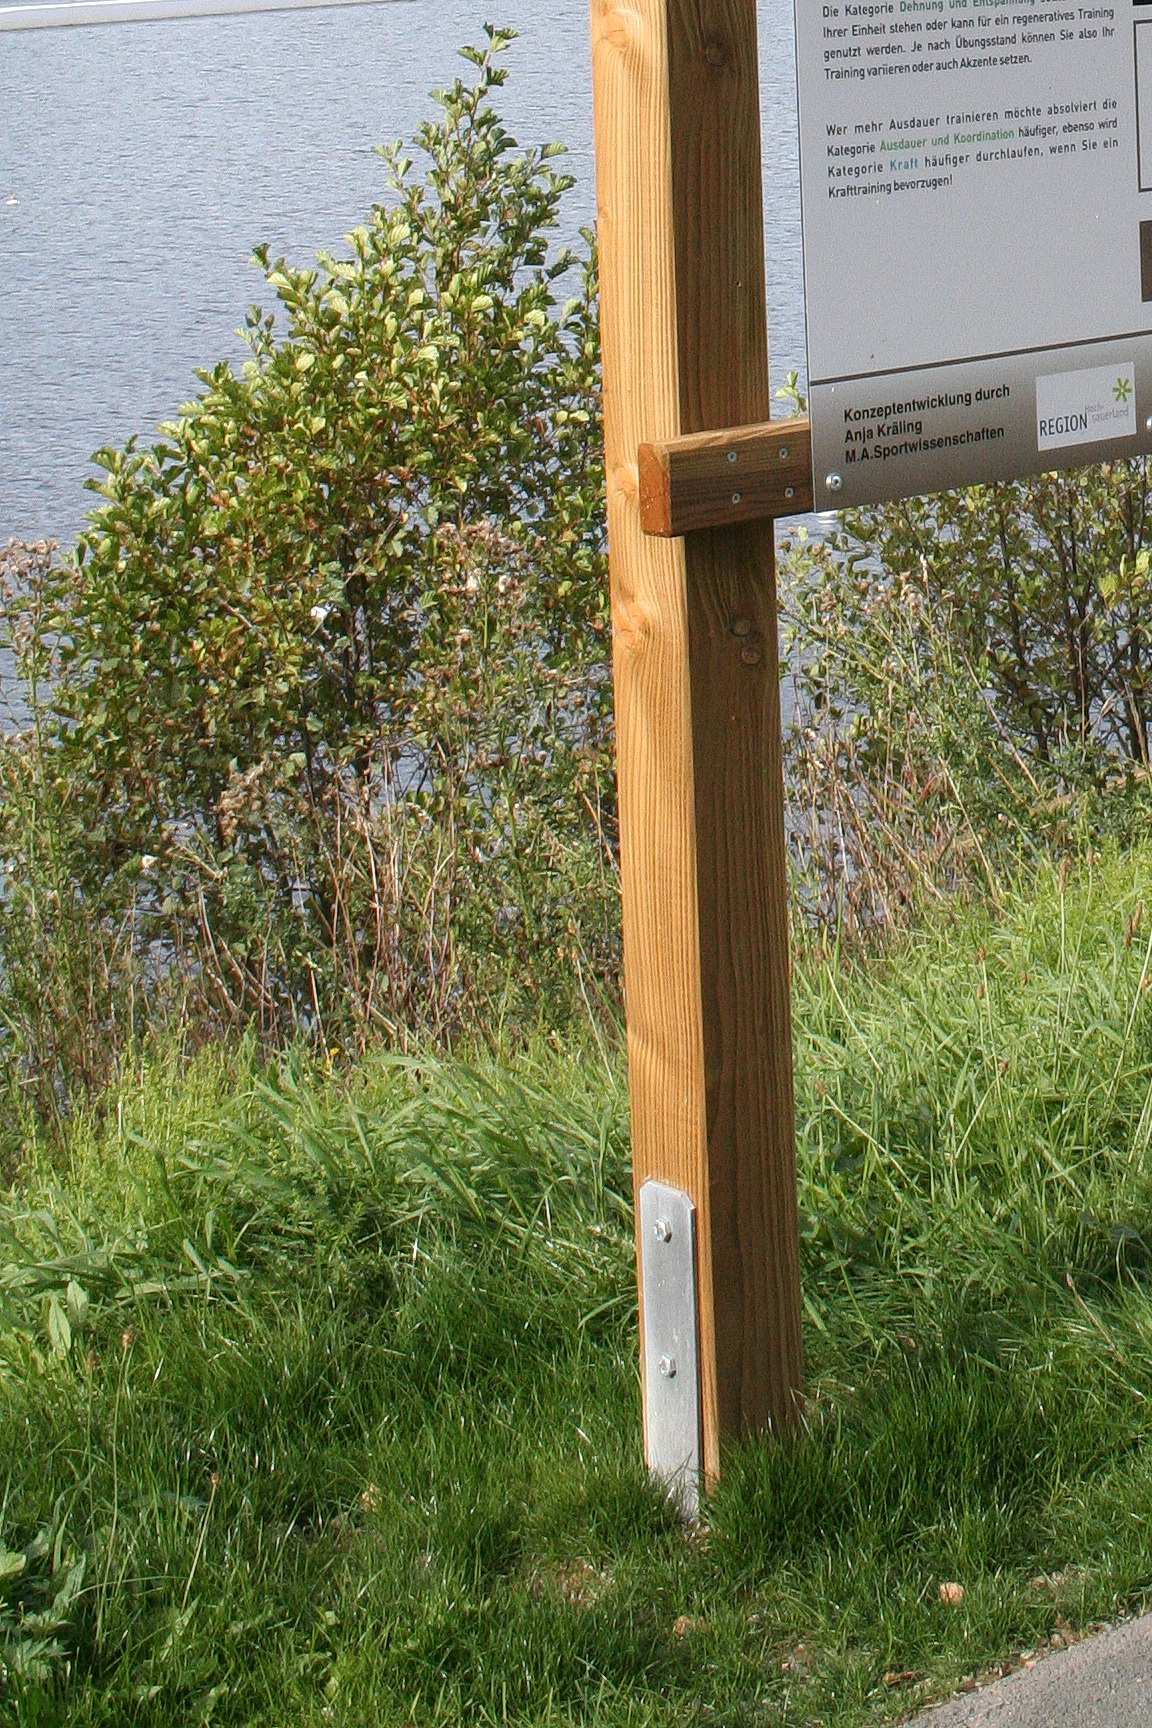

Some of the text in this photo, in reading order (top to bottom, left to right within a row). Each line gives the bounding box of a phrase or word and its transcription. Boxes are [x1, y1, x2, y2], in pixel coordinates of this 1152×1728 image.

[844, 383, 1010, 426] Konzeptentwicklung durch
[844, 417, 922, 446] Anja Kräling
[1040, 413, 1088, 436] REGION
[845, 424, 1004, 467] M.A.Sportwissenschaften
